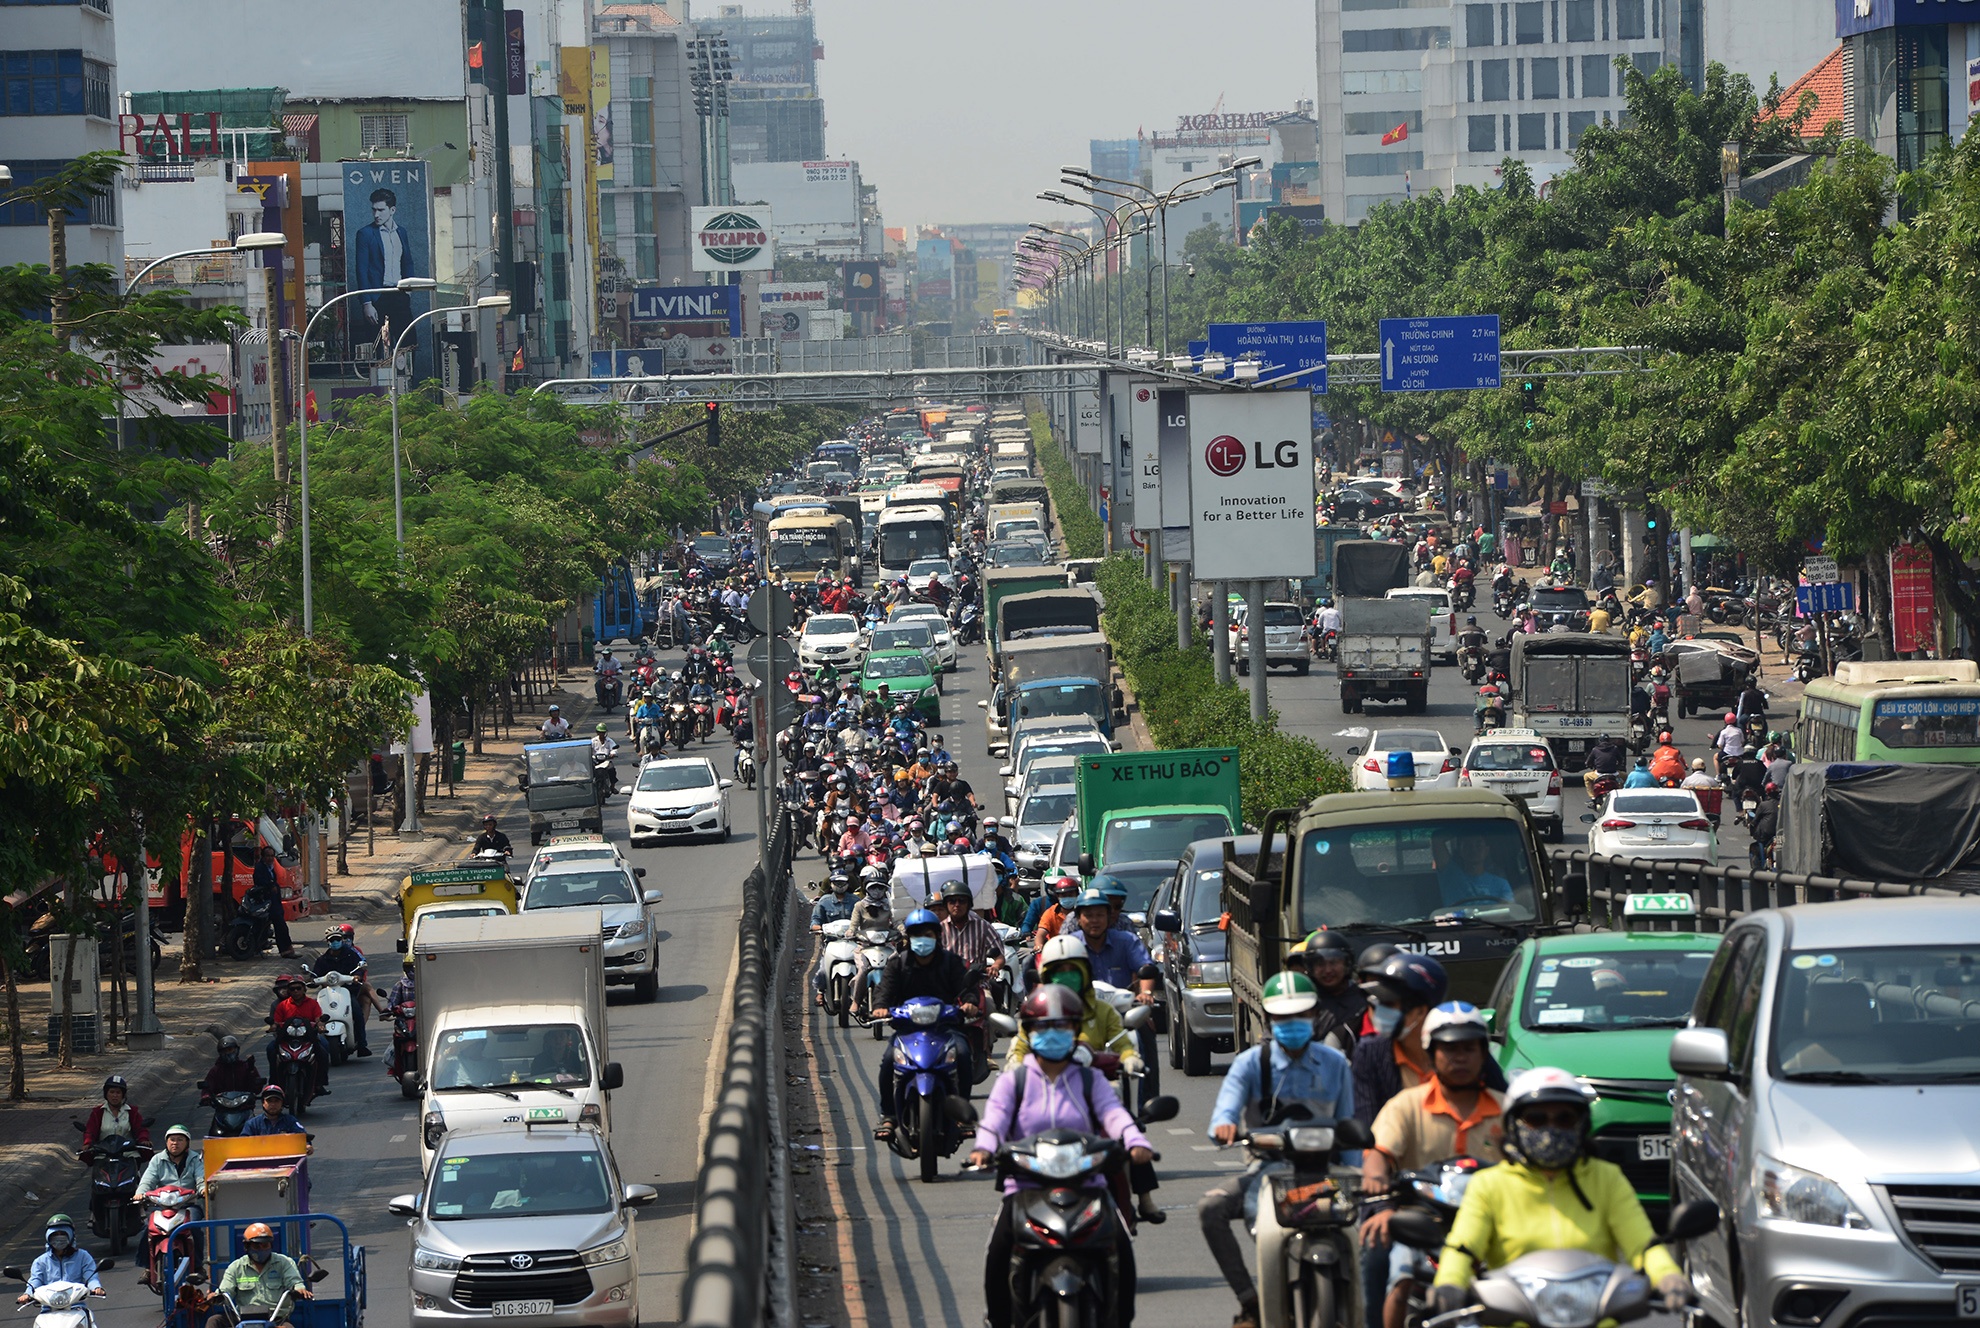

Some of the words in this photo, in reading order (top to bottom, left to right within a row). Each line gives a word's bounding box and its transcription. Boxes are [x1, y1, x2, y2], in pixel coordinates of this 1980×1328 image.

[510, 40, 521, 80] TPBank
[349, 168, 419, 185] OWEN
[698, 231, 768, 247] TECAPRO
[633, 294, 713, 317] LIVINI
[1484, 328, 1496, 338] Km
[1237, 335, 1262, 345] HOÀNG
[1263, 335, 1278, 345] VĂN
[1279, 335, 1294, 346] THỤ
[1310, 334, 1322, 344] Km
[1310, 358, 1323, 367] Km
[1401, 355, 1412, 365] AN
[1484, 352, 1497, 362] Km
[1311, 383, 1323, 392] Km
[1401, 378, 1412, 389] CỦ
[1413, 379, 1425, 388] CHI
[1476, 377, 1484, 386] 18
[1485, 377, 1498, 386] Km
[1081, 411, 1093, 419] LG
[1167, 415, 1186, 427] LG
[1254, 440, 1299, 469] LG
[1144, 465, 1159, 476] LG
[1142, 481, 1156, 489] Bán
[1220, 495, 1286, 507] Innovation
[1203, 510, 1222, 522] for
[1225, 512, 1232, 521] a
[1236, 508, 1278, 521] Better
[1281, 508, 1304, 520] Life
[1897, 703, 1906, 713] XE
[1907, 702, 1923, 716] CHỢ
[1923, 701, 1938, 713] LỚN
[1943, 702, 1958, 716] CHỢ
[1959, 701, 1976, 716] HIỆP
[1924, 731, 1945, 744] 145
[1111, 765, 1134, 782] XE
[1137, 763, 1175, 780] THƯ
[1180, 759, 1221, 778] BÁO
[411, 874, 421, 882] 10
[1393, 939, 1461, 957] SUZU
[1485, 937, 1518, 947] NKR
[494, 1301, 552, 1316] 51G-350.77
